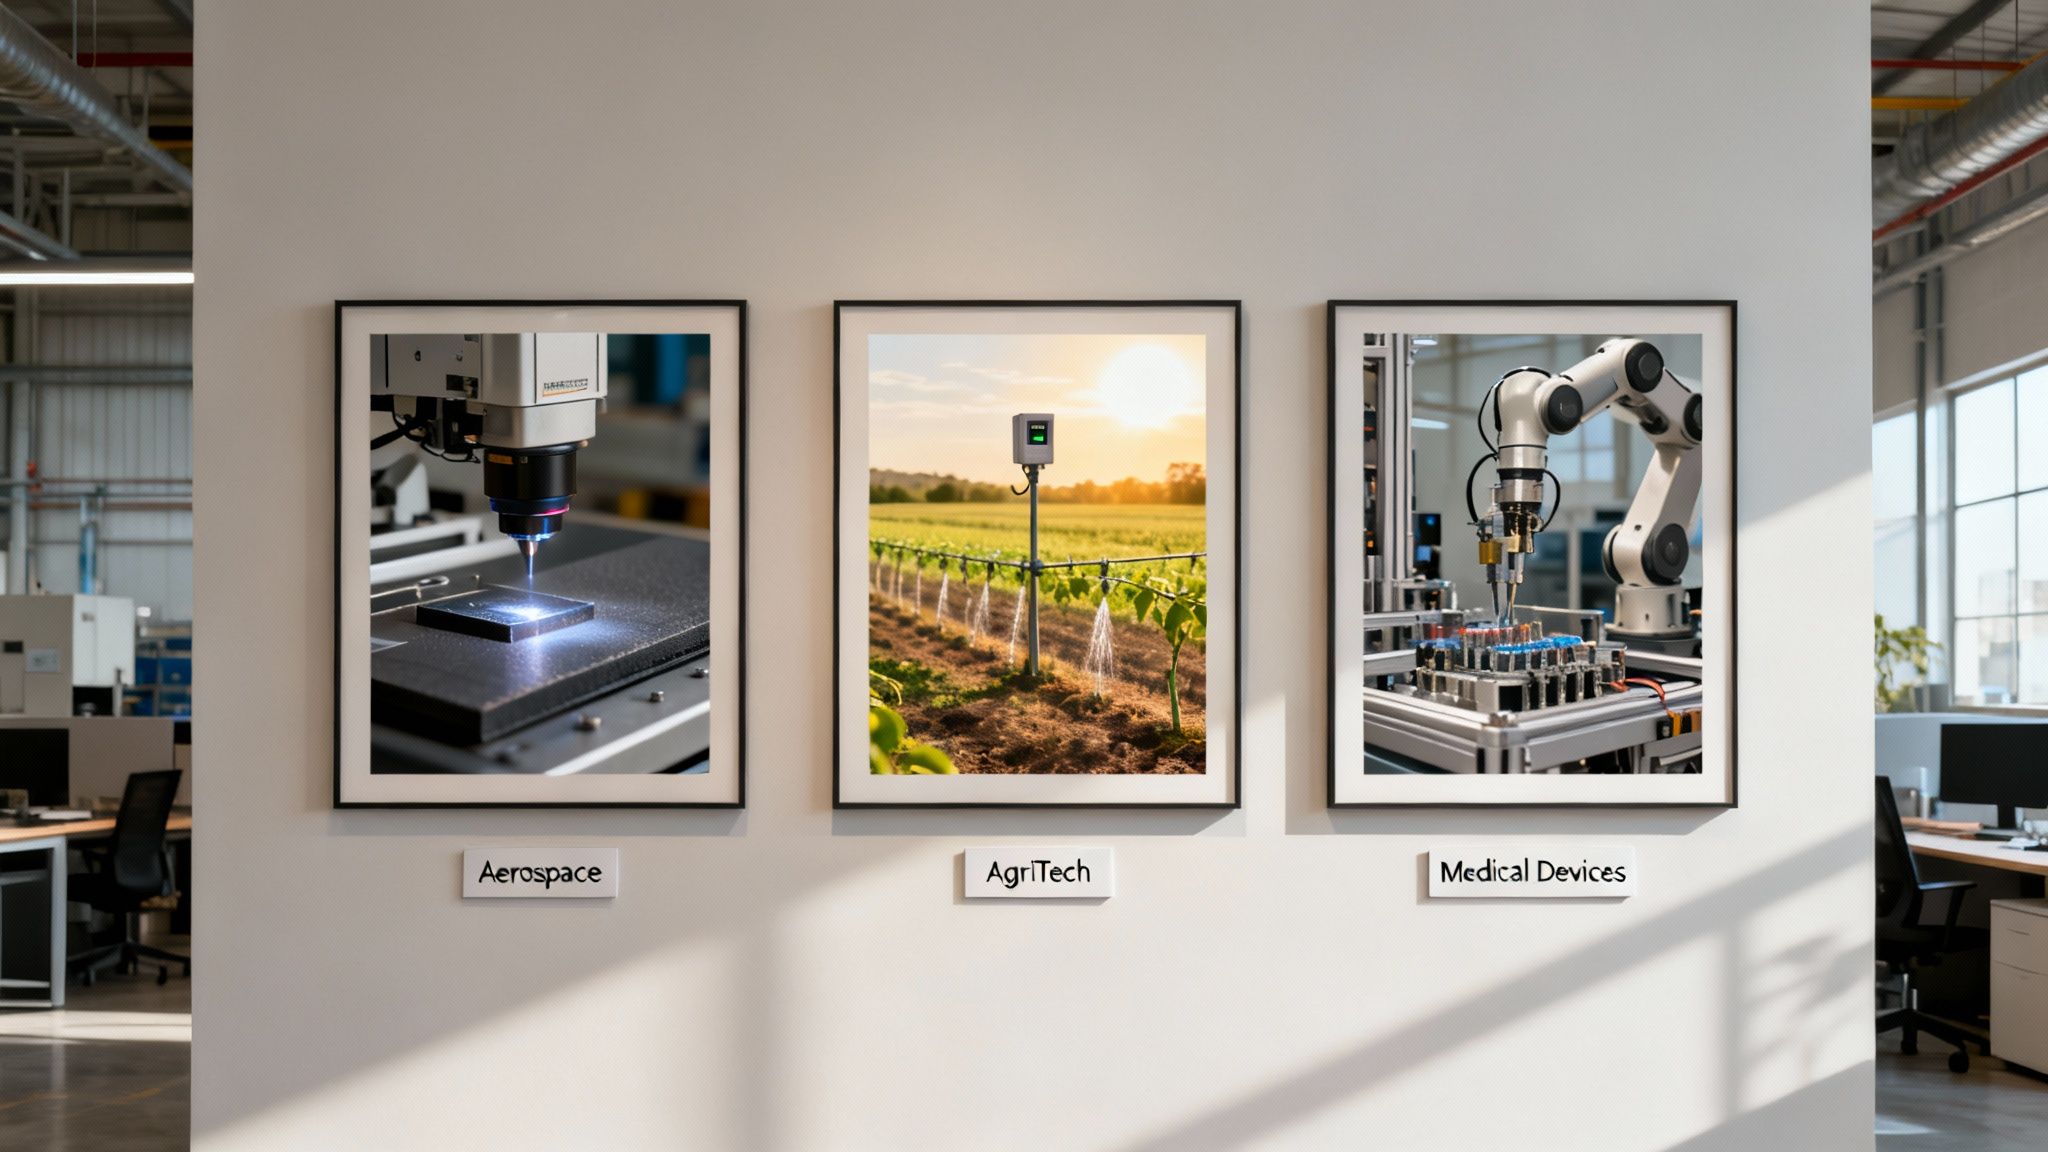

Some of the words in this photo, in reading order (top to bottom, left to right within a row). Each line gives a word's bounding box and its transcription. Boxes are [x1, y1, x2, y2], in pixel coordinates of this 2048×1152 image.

[478, 860, 602, 889] Aerospace
[986, 858, 1091, 889] AgriTech
[1440, 858, 1529, 882] Medical
[1537, 859, 1626, 882] Devices
